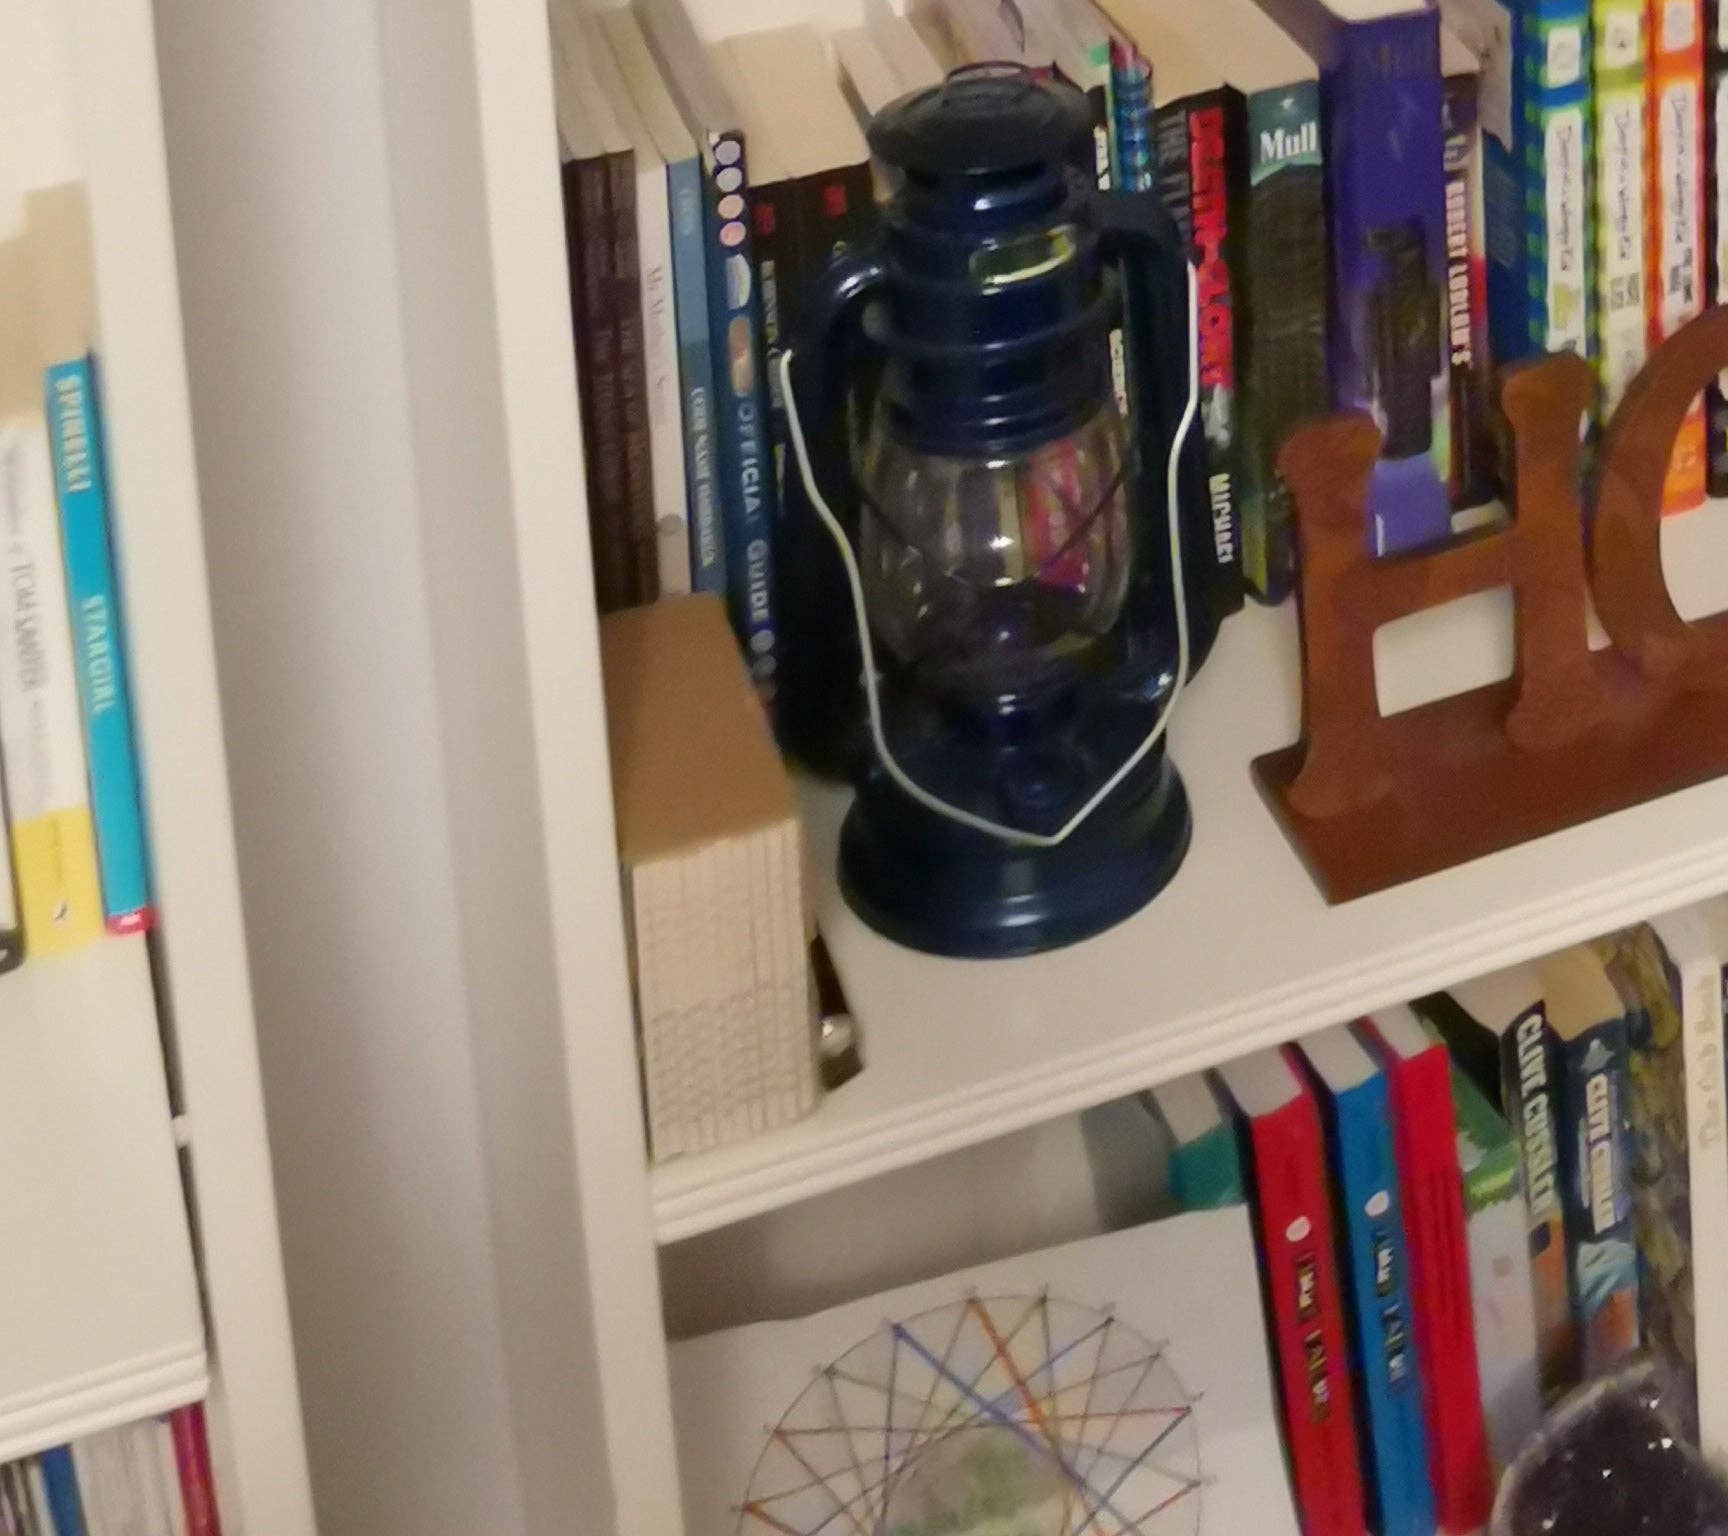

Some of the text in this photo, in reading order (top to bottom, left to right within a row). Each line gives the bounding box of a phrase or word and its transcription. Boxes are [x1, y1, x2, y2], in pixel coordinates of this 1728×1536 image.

[1260, 126, 1319, 164] Mull
[1445, 180, 1473, 367] ROBERT LUDLUM'S
[54, 374, 93, 493] SPINELLI
[9, 562, 37, 612] TOM
[745, 538, 770, 625] GUIDE
[82, 595, 115, 713] STARGIRL
[1516, 1013, 1560, 1216] CLIVE CUSSLER
